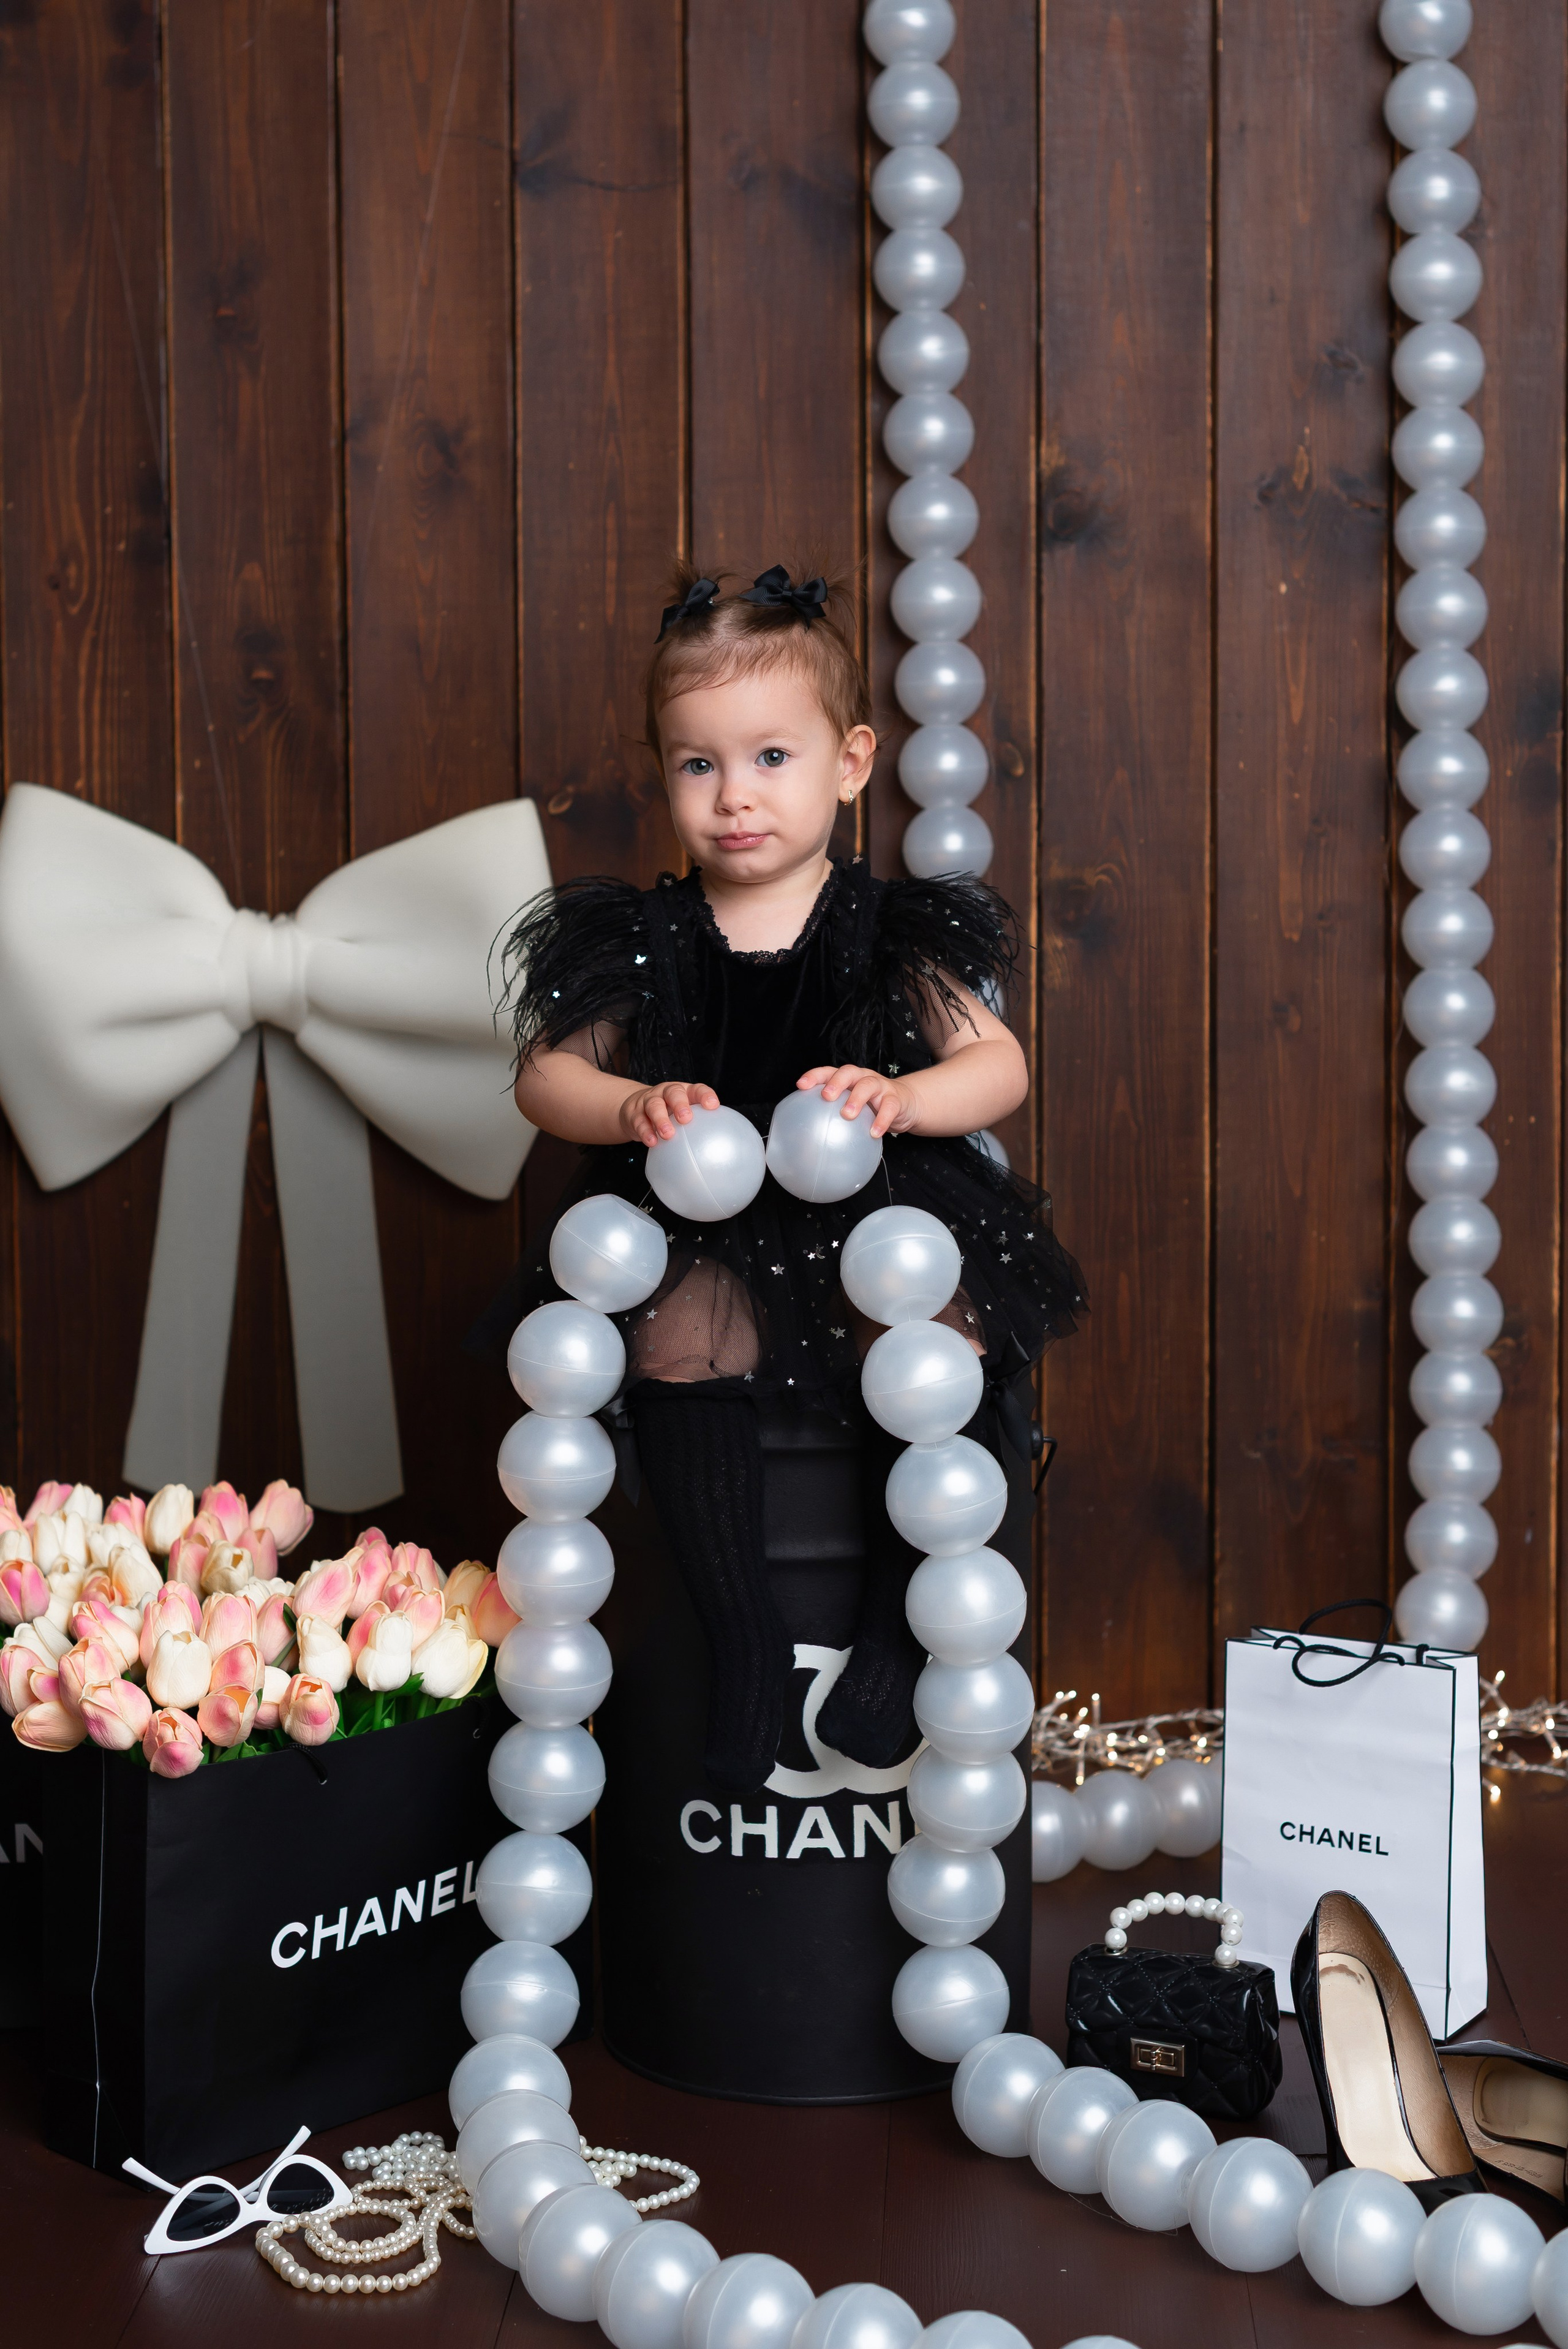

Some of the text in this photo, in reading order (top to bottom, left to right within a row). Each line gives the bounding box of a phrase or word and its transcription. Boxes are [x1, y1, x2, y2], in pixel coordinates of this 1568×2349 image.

[680, 1799, 921, 1859] CHAN
[1280, 1821, 1389, 1856] CHANEL
[271, 1860, 477, 1969] CHANEL
